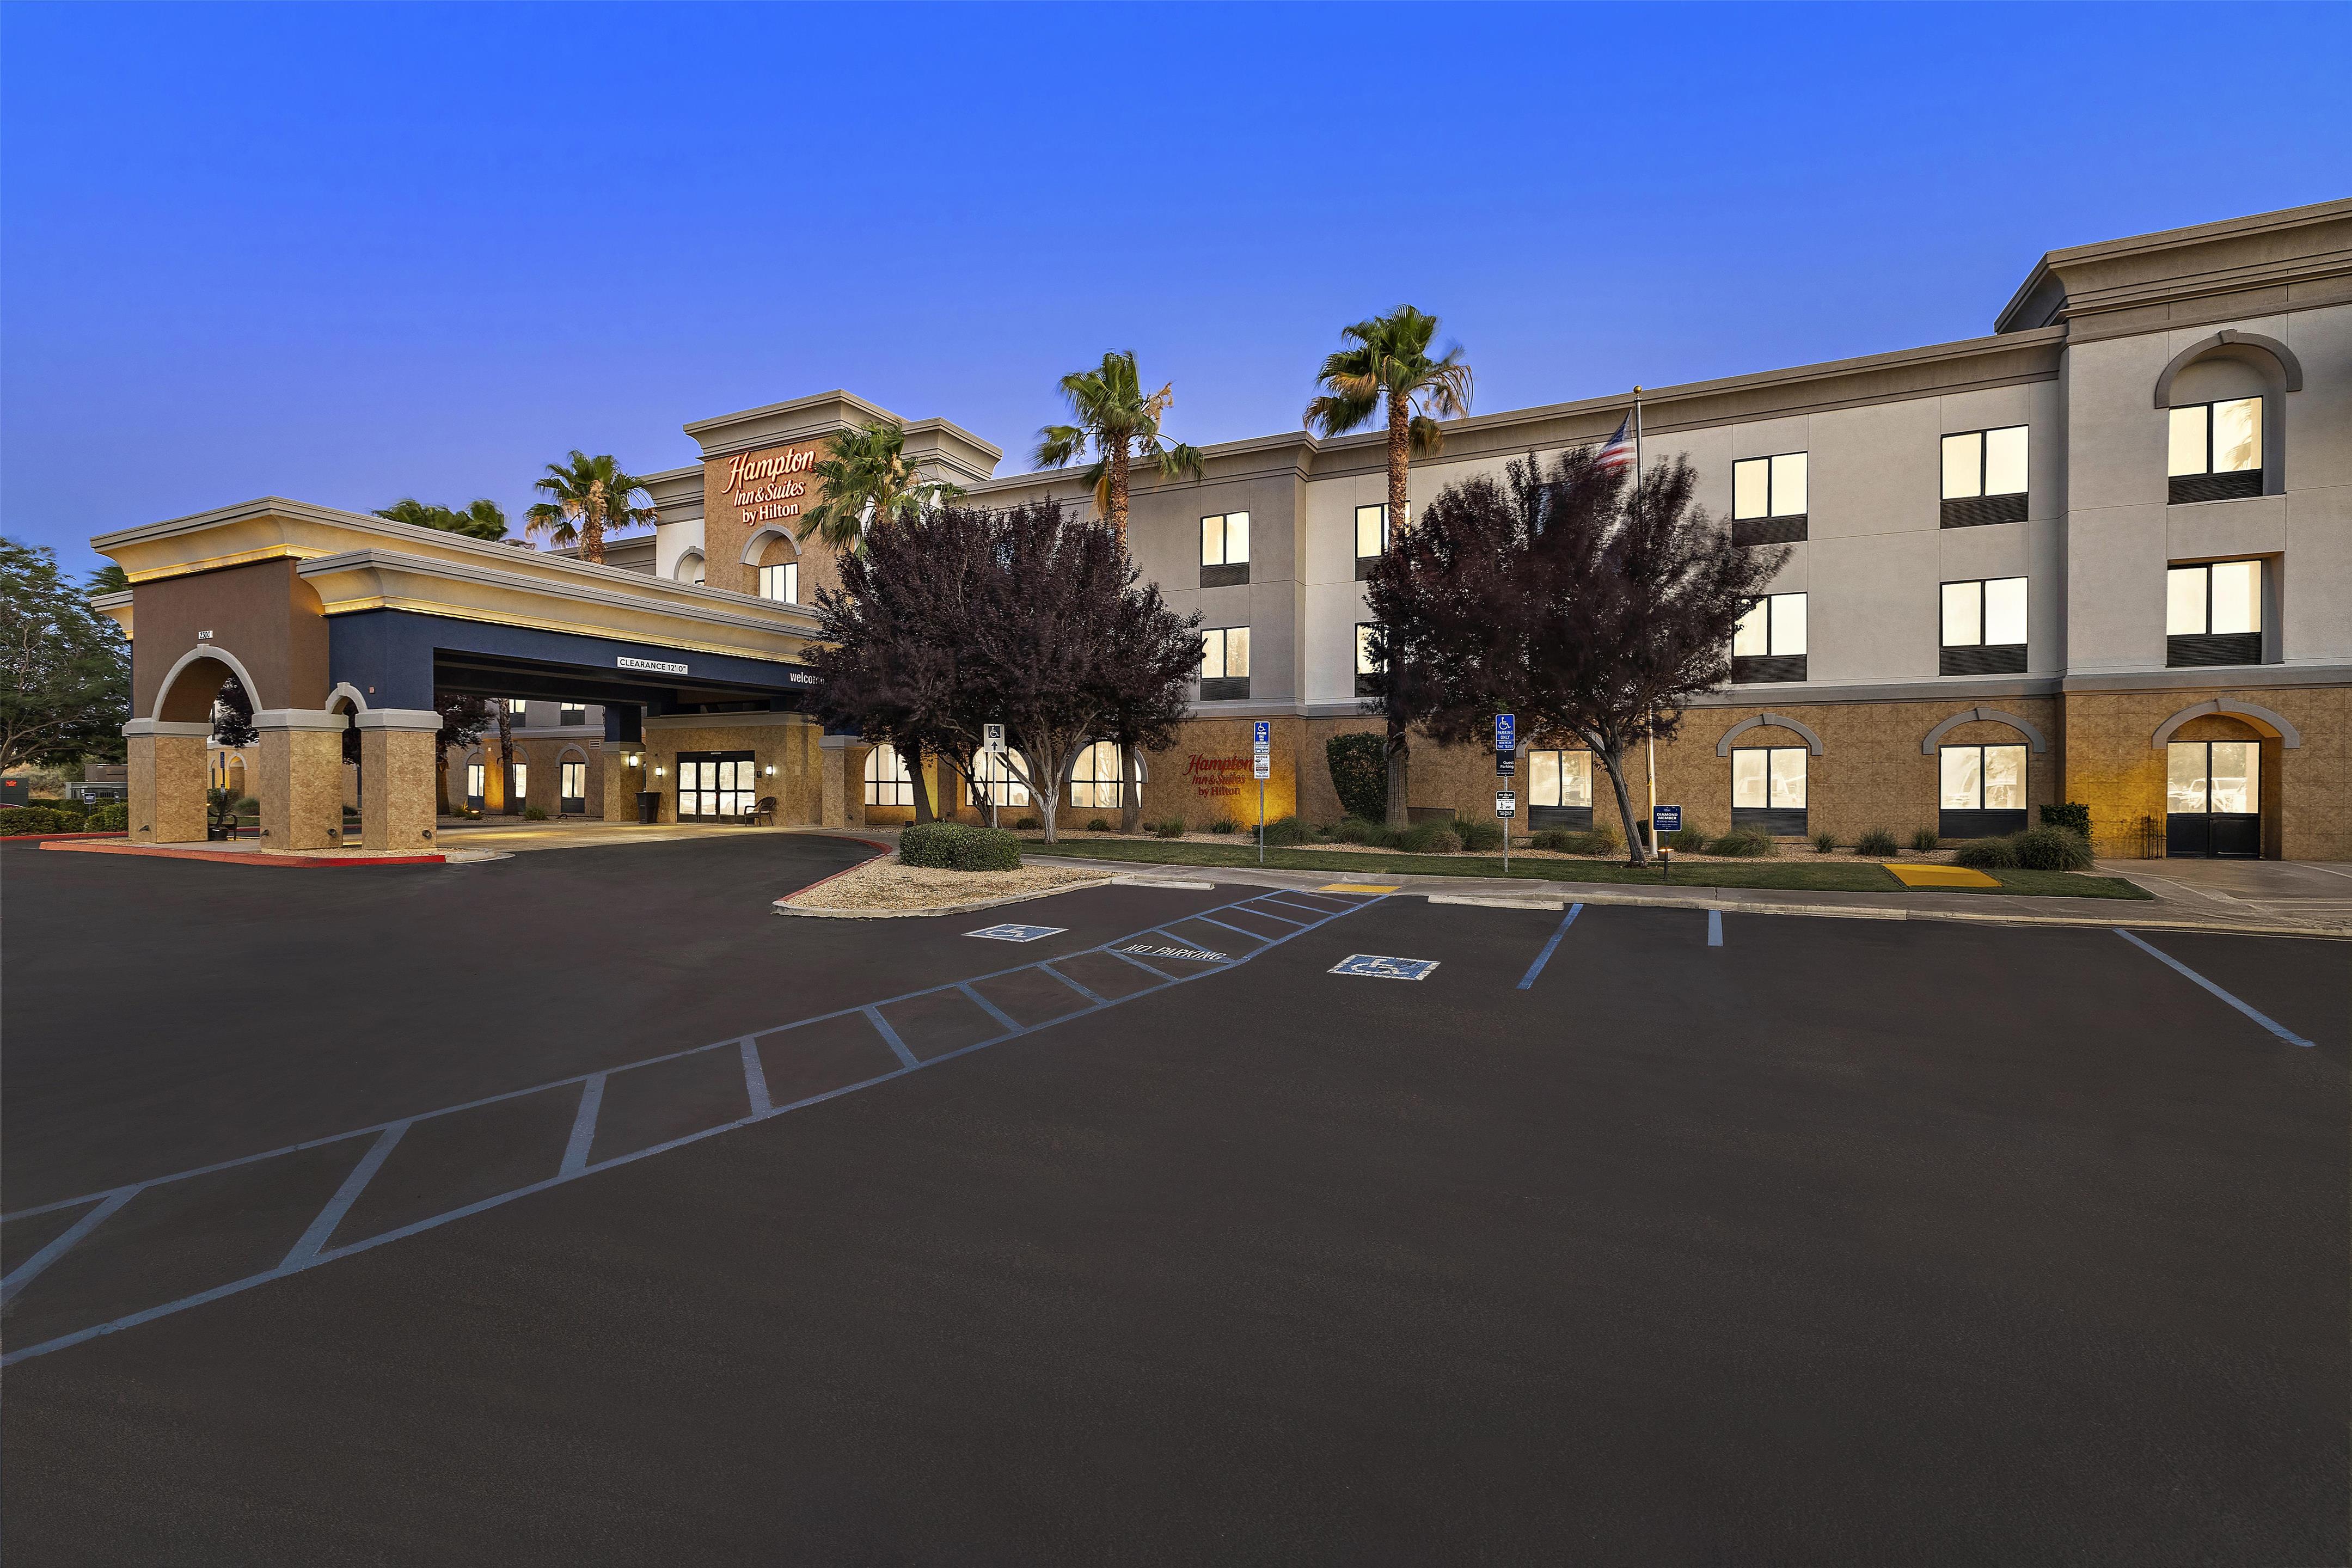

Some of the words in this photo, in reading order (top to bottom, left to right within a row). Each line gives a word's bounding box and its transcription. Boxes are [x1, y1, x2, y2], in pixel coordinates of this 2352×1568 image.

[721, 448, 816, 494] Hampton
[733, 489, 755, 506] Inn
[755, 487, 764, 503] &
[764, 480, 806, 501] Suites
[742, 509, 758, 526] by
[759, 503, 800, 520] Hilton
[620, 659, 666, 670] CLEARANCE
[1182, 752, 1254, 775] Hampton
[1192, 774, 1208, 785] Inn
[1209, 775, 1216, 785] &
[1216, 773, 1246, 785] Suites
[1198, 787, 1210, 798] by
[1211, 786, 1241, 795] Hilton
[1122, 944, 1153, 953] NO
[1151, 946, 1227, 960] PARKING
